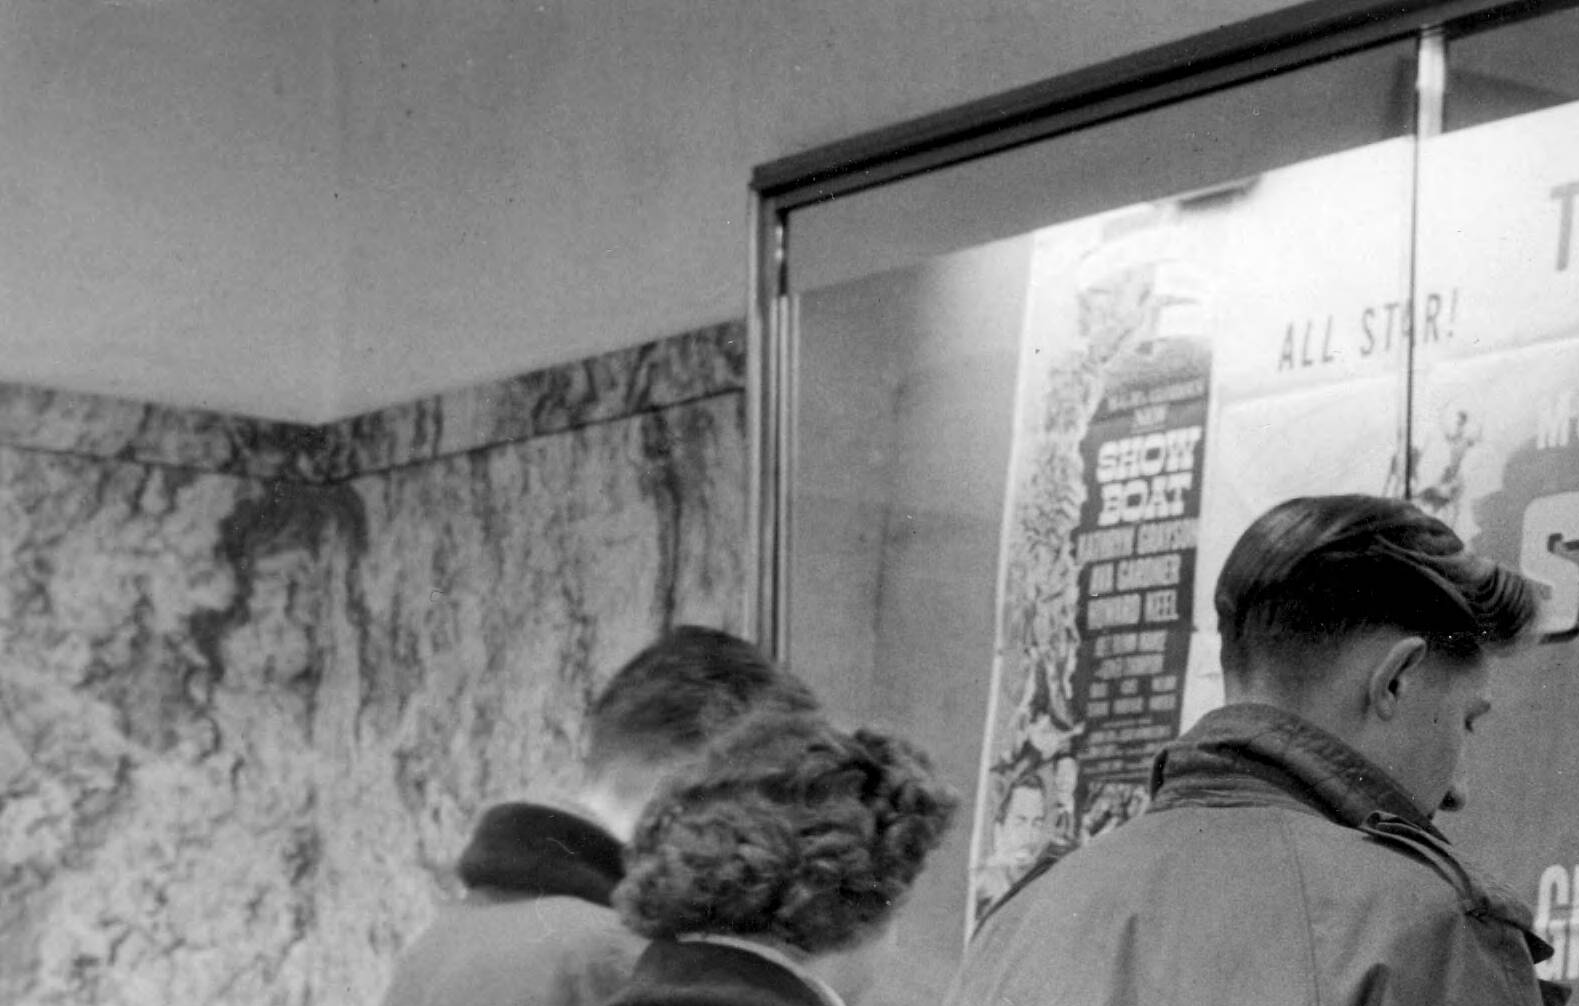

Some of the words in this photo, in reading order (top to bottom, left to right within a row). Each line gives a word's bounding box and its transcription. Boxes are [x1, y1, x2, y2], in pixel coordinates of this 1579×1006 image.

[1278, 314, 1334, 372] ALL
[1097, 426, 1201, 484] SHOW
[1098, 472, 1192, 527] BOAT
